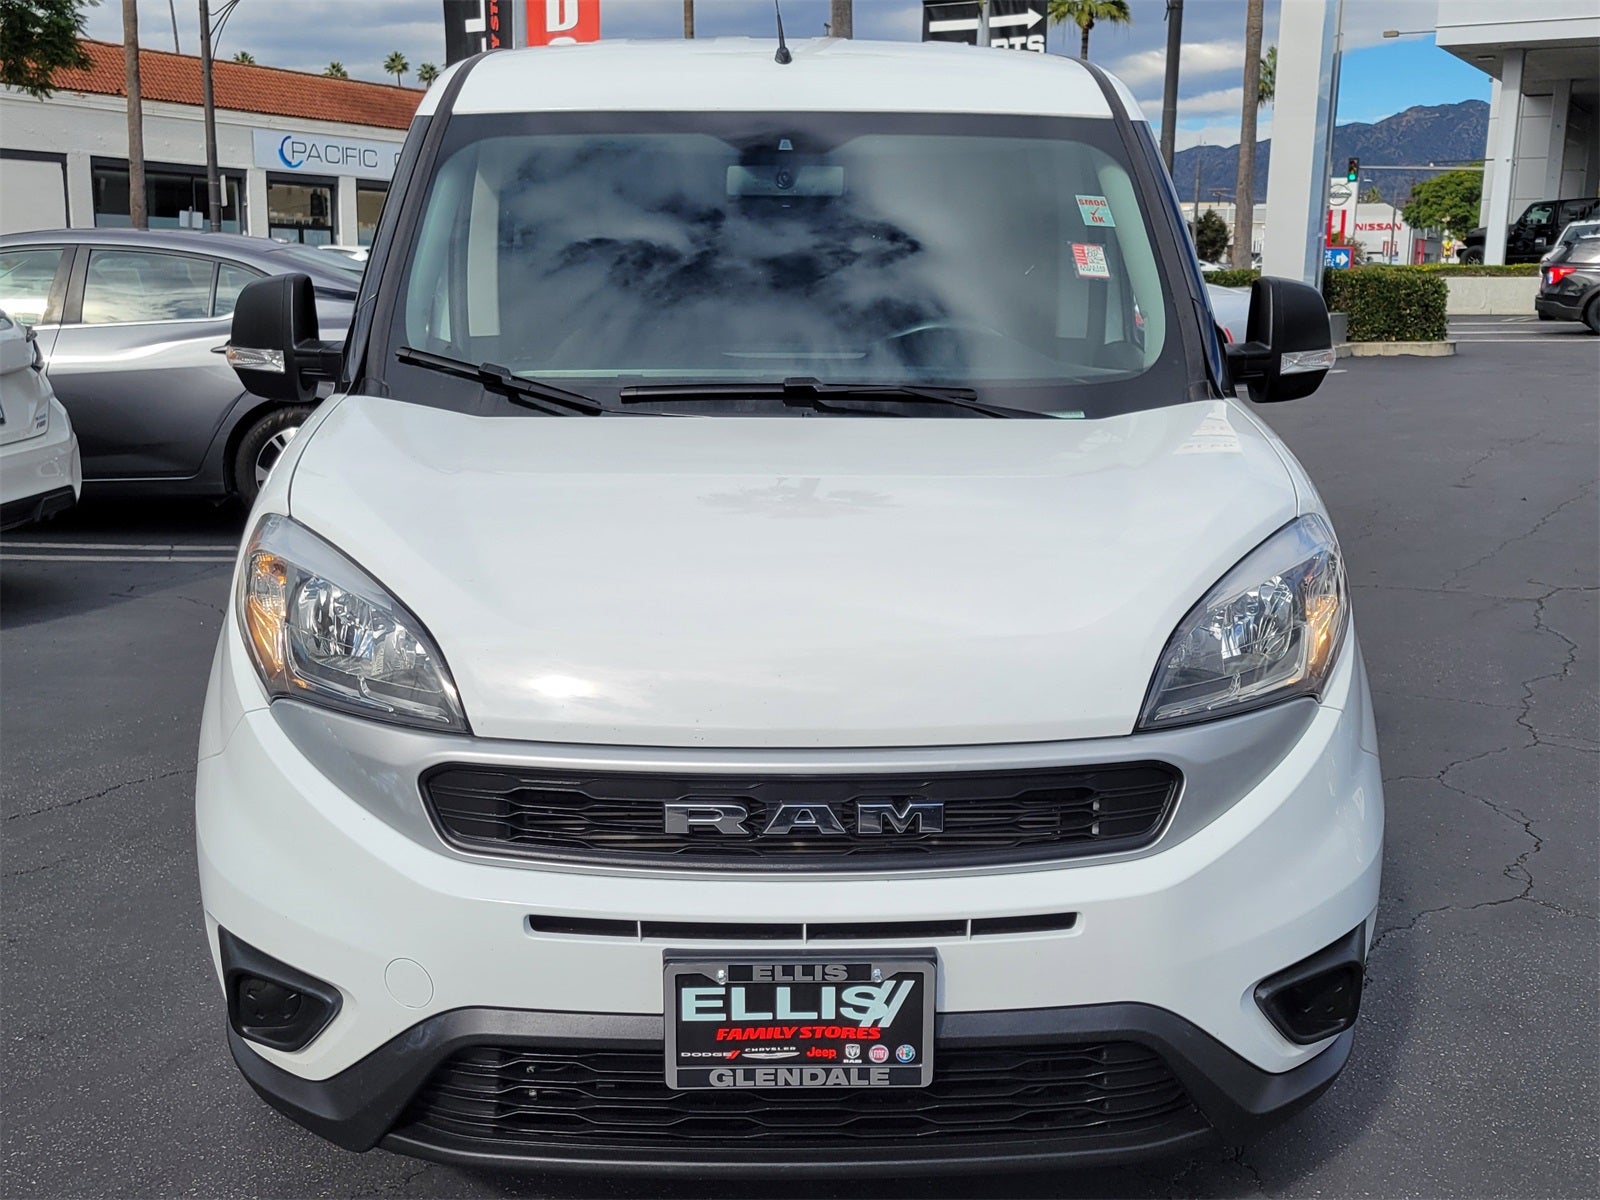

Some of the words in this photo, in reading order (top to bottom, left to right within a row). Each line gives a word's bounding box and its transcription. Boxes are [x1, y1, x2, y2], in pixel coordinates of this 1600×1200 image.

[291, 141, 378, 168] PACIFIC
[1079, 198, 1106, 207] SMOG
[1091, 216, 1106, 224] OK
[1355, 222, 1402, 231] NISSAN
[664, 803, 944, 835] RAM
[752, 964, 849, 982] ELLIS
[681, 985, 893, 1022] ELLIS
[716, 1027, 797, 1041] FAMILY
[799, 1026, 881, 1041] STORES
[806, 1046, 837, 1060] Jeep
[709, 1067, 890, 1087] GLENDALE
